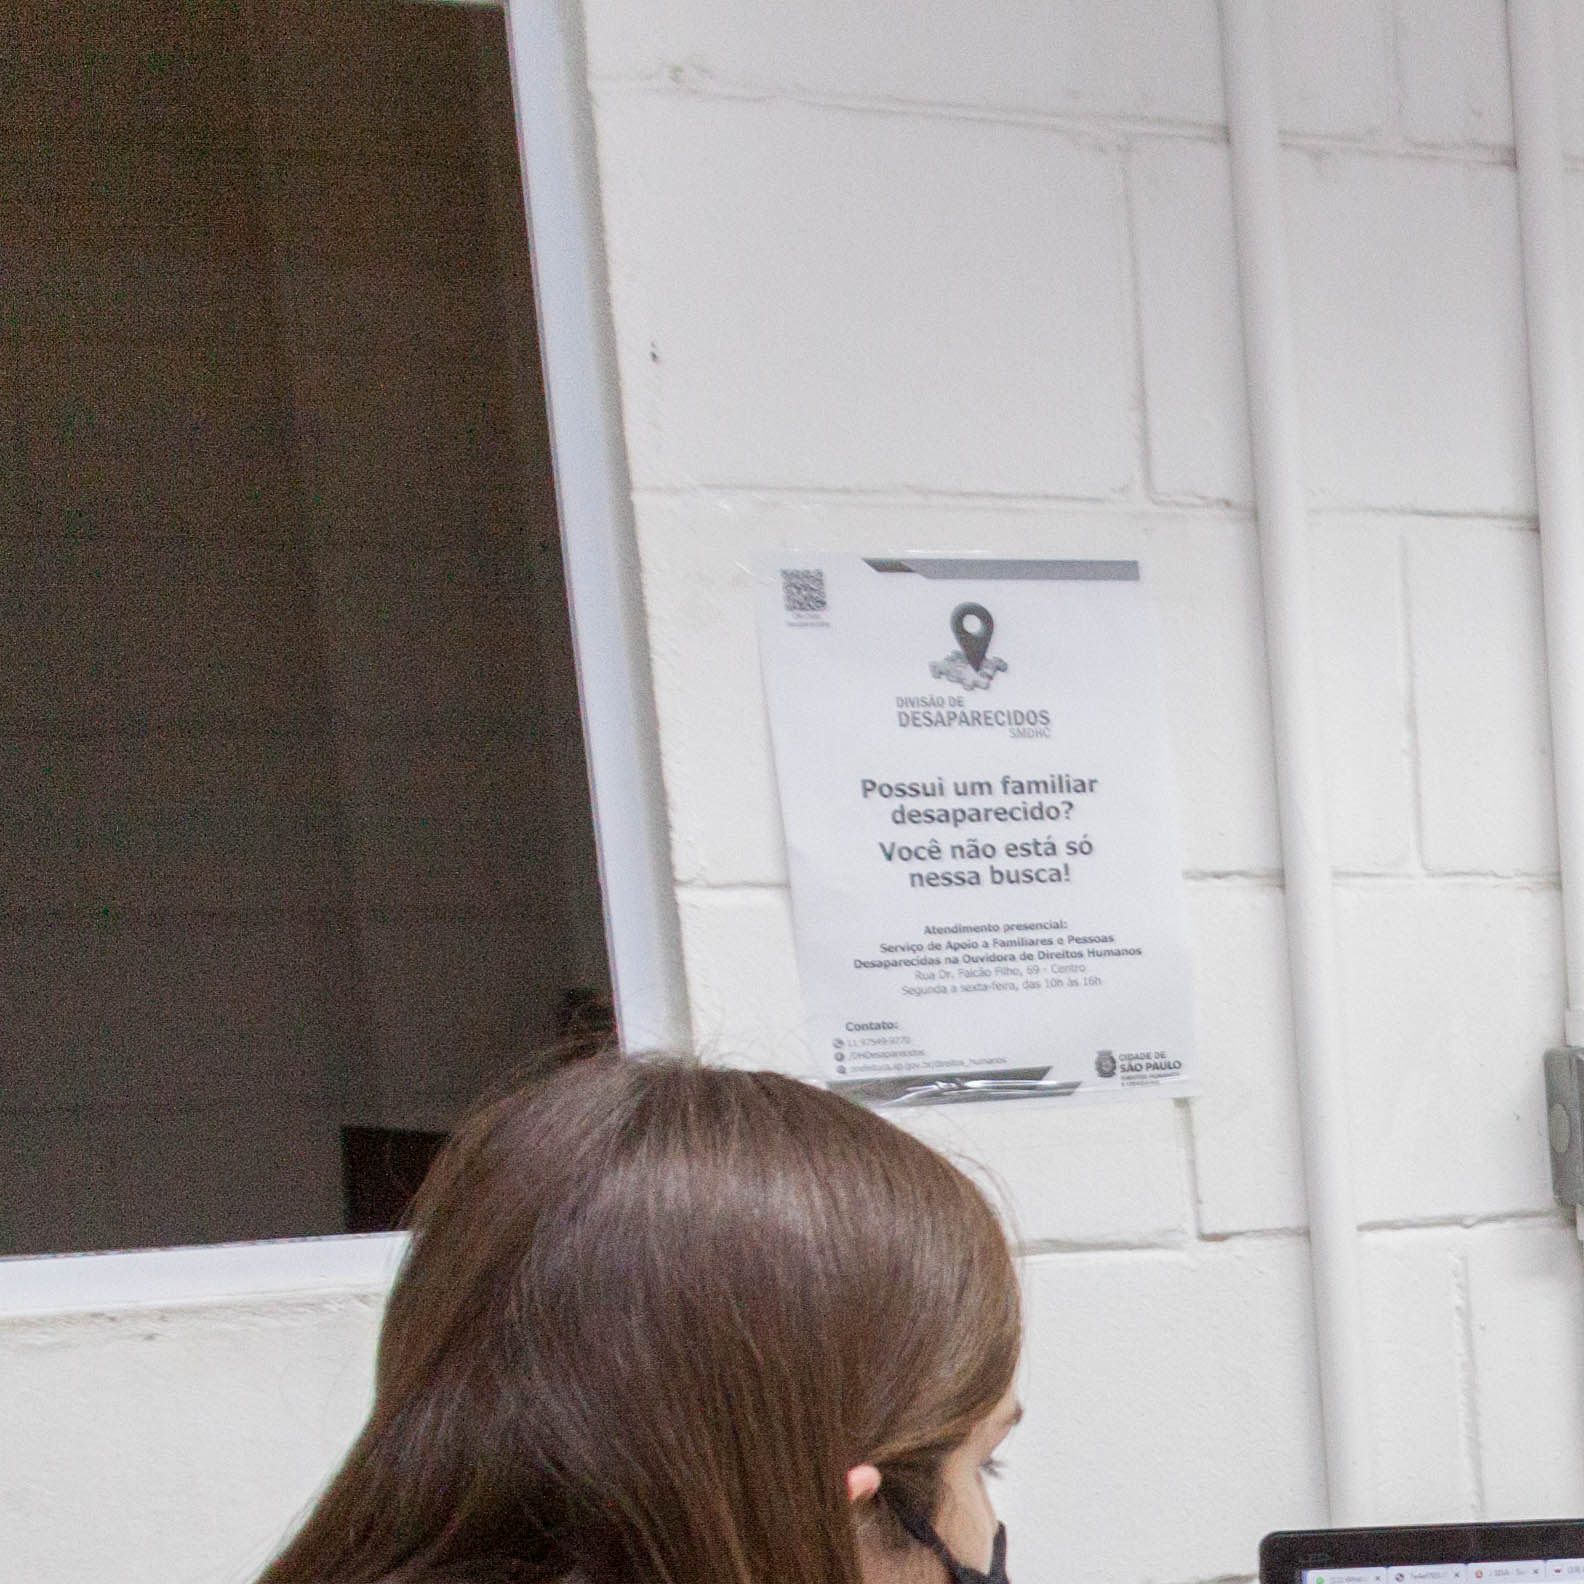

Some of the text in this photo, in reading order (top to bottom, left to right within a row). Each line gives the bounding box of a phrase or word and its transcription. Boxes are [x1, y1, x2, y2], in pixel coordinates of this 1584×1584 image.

[948, 696, 965, 708] DE
[898, 709, 1052, 728] DESAPARECIDOS
[860, 774, 1098, 799] Possui um familiar
[891, 801, 1074, 829] desaparecido?
[879, 834, 1094, 862] Você não está só
[909, 863, 1071, 888] nessa busca!
[923, 920, 1068, 936] Atendimento presencial:
[880, 934, 1114, 954] Serviço de Apoio a Familiares e Pessoas
[853, 956, 941, 970] Desaparecidas
[945, 955, 958, 965] na
[1019, 950, 1034, 961] de
[1038, 948, 1083, 960] Direitos
[1087, 946, 1142, 957] Humanos
[915, 970, 935, 980] Rua
[938, 969, 954, 980] Dr.
[958, 965, 992, 978] Falcão
[1052, 962, 1086, 974] Centro
[901, 984, 948, 998] Segunda
[1022, 980, 1041, 991] das
[845, 1020, 898, 1032] Contato:
[1119, 1051, 1167, 1061] CIDADE DE
[1120, 1060, 1182, 1073] SÃO PAULO
